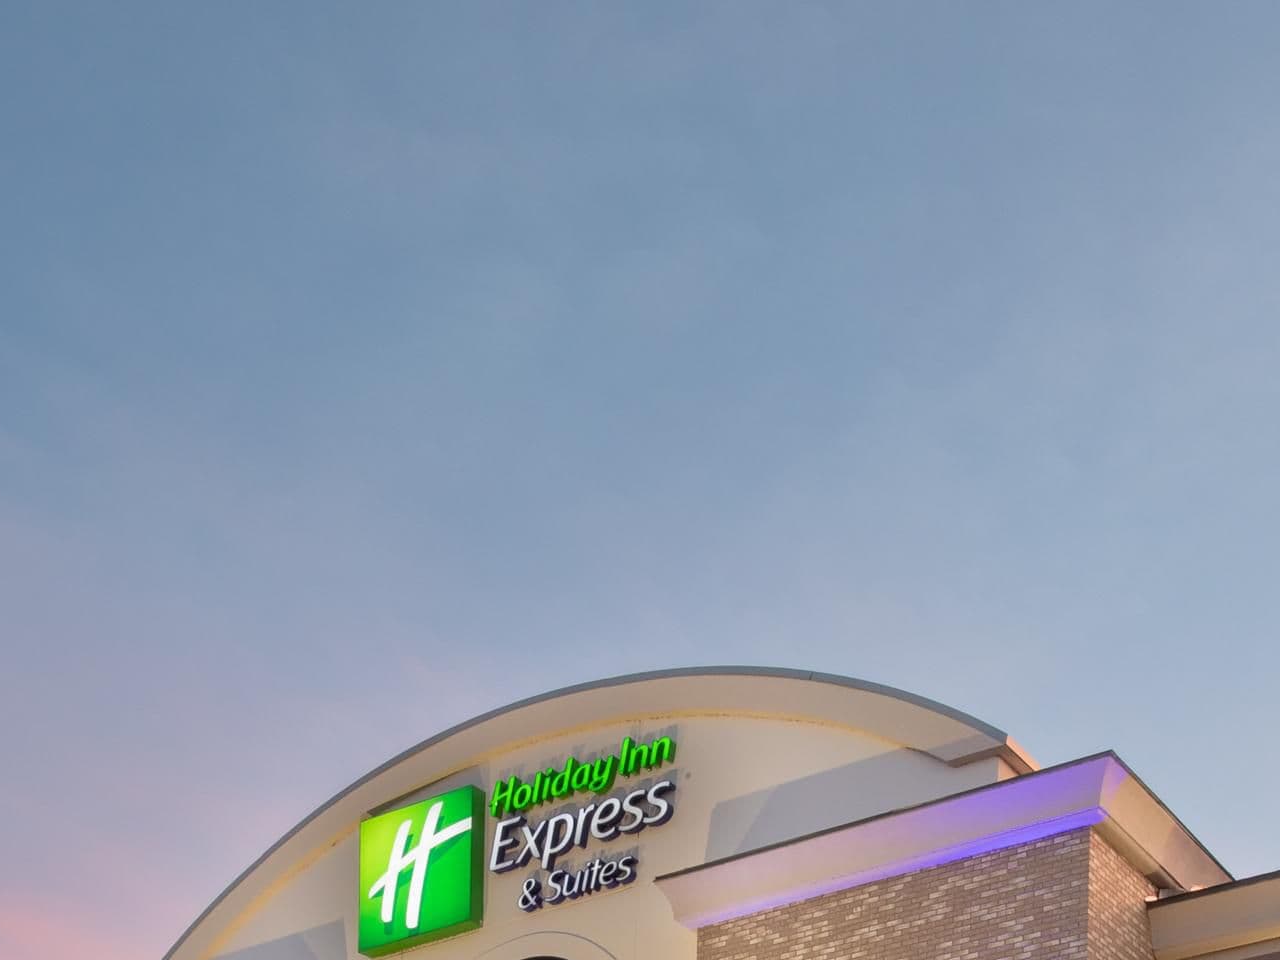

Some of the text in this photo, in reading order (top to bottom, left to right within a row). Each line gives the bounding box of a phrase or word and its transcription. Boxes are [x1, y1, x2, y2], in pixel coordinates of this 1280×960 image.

[489, 735, 675, 818] Holiday Inn
[489, 780, 675, 873] Express
[518, 855, 638, 911] & Suites
